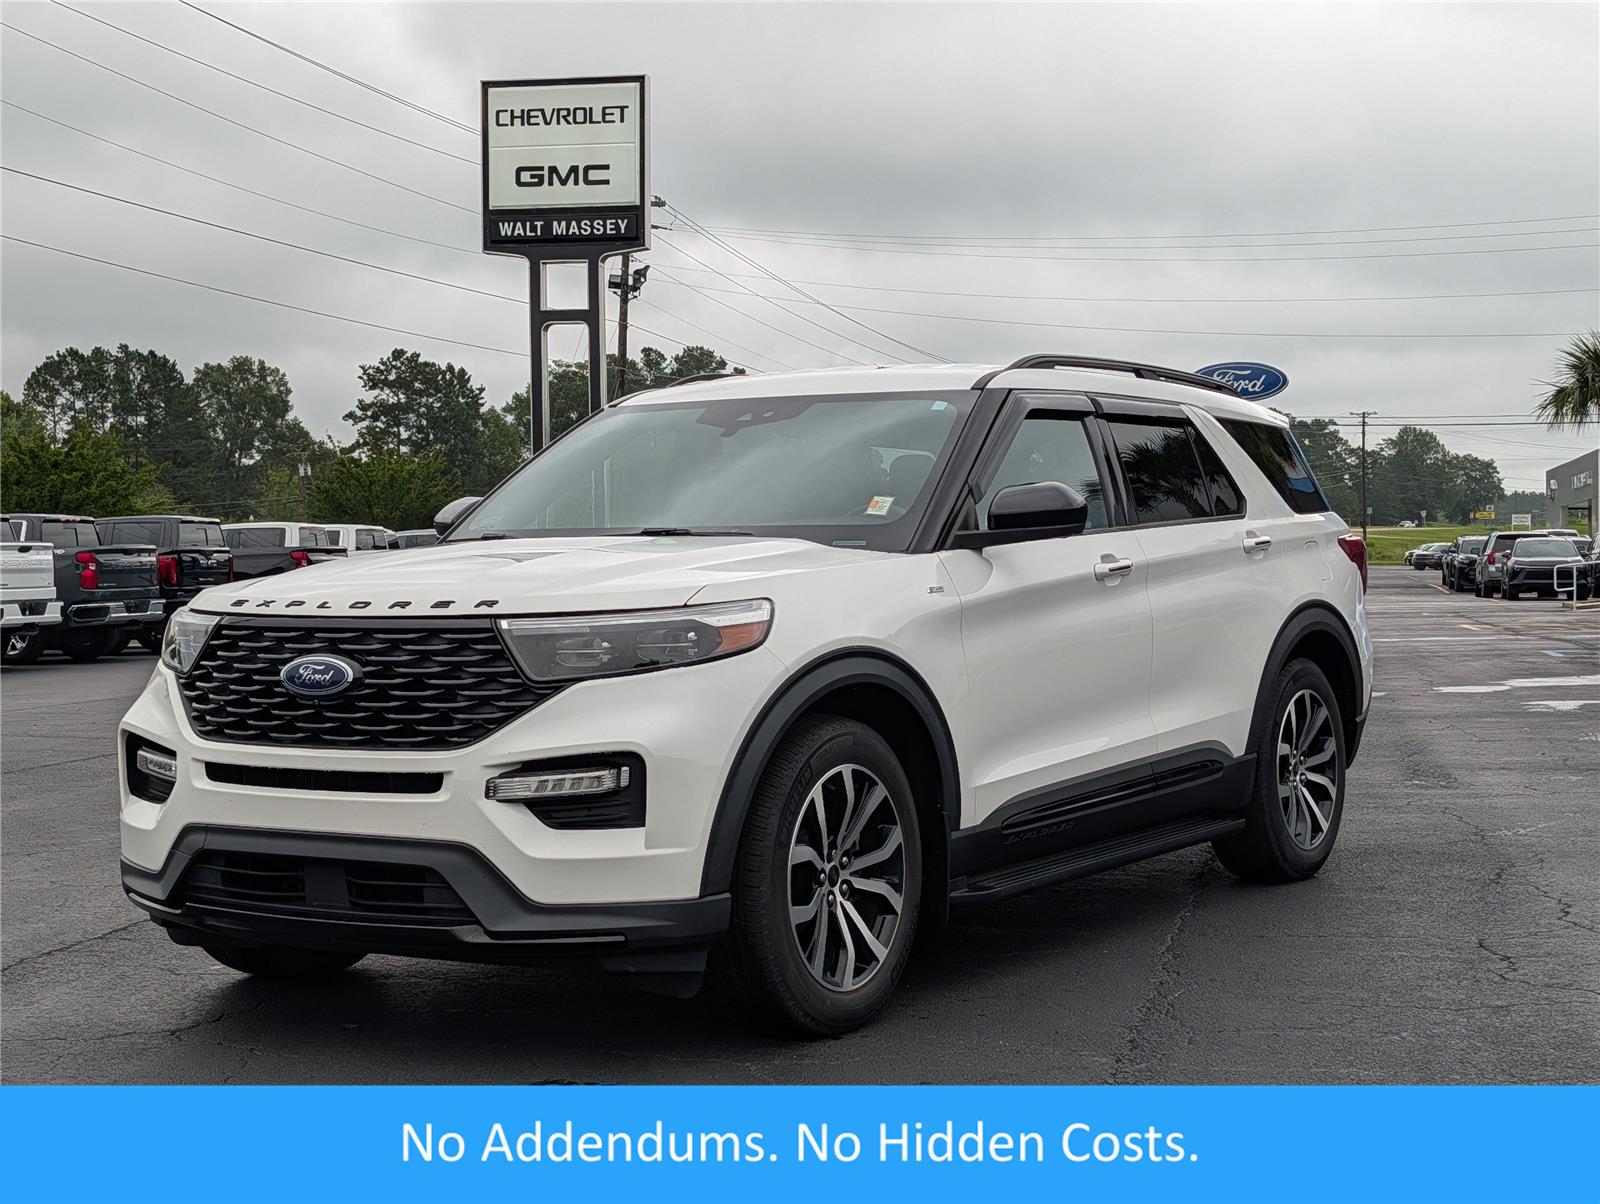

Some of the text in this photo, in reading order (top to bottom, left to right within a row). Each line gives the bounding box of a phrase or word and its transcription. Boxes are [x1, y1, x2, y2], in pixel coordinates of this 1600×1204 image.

[495, 105, 629, 127] CHEVROLET
[515, 164, 610, 187] GMC
[499, 219, 628, 237] WALT MASSEY
[1213, 369, 1267, 392] Ford
[230, 599, 500, 609] EXPLORER
[295, 664, 334, 685] Ford
